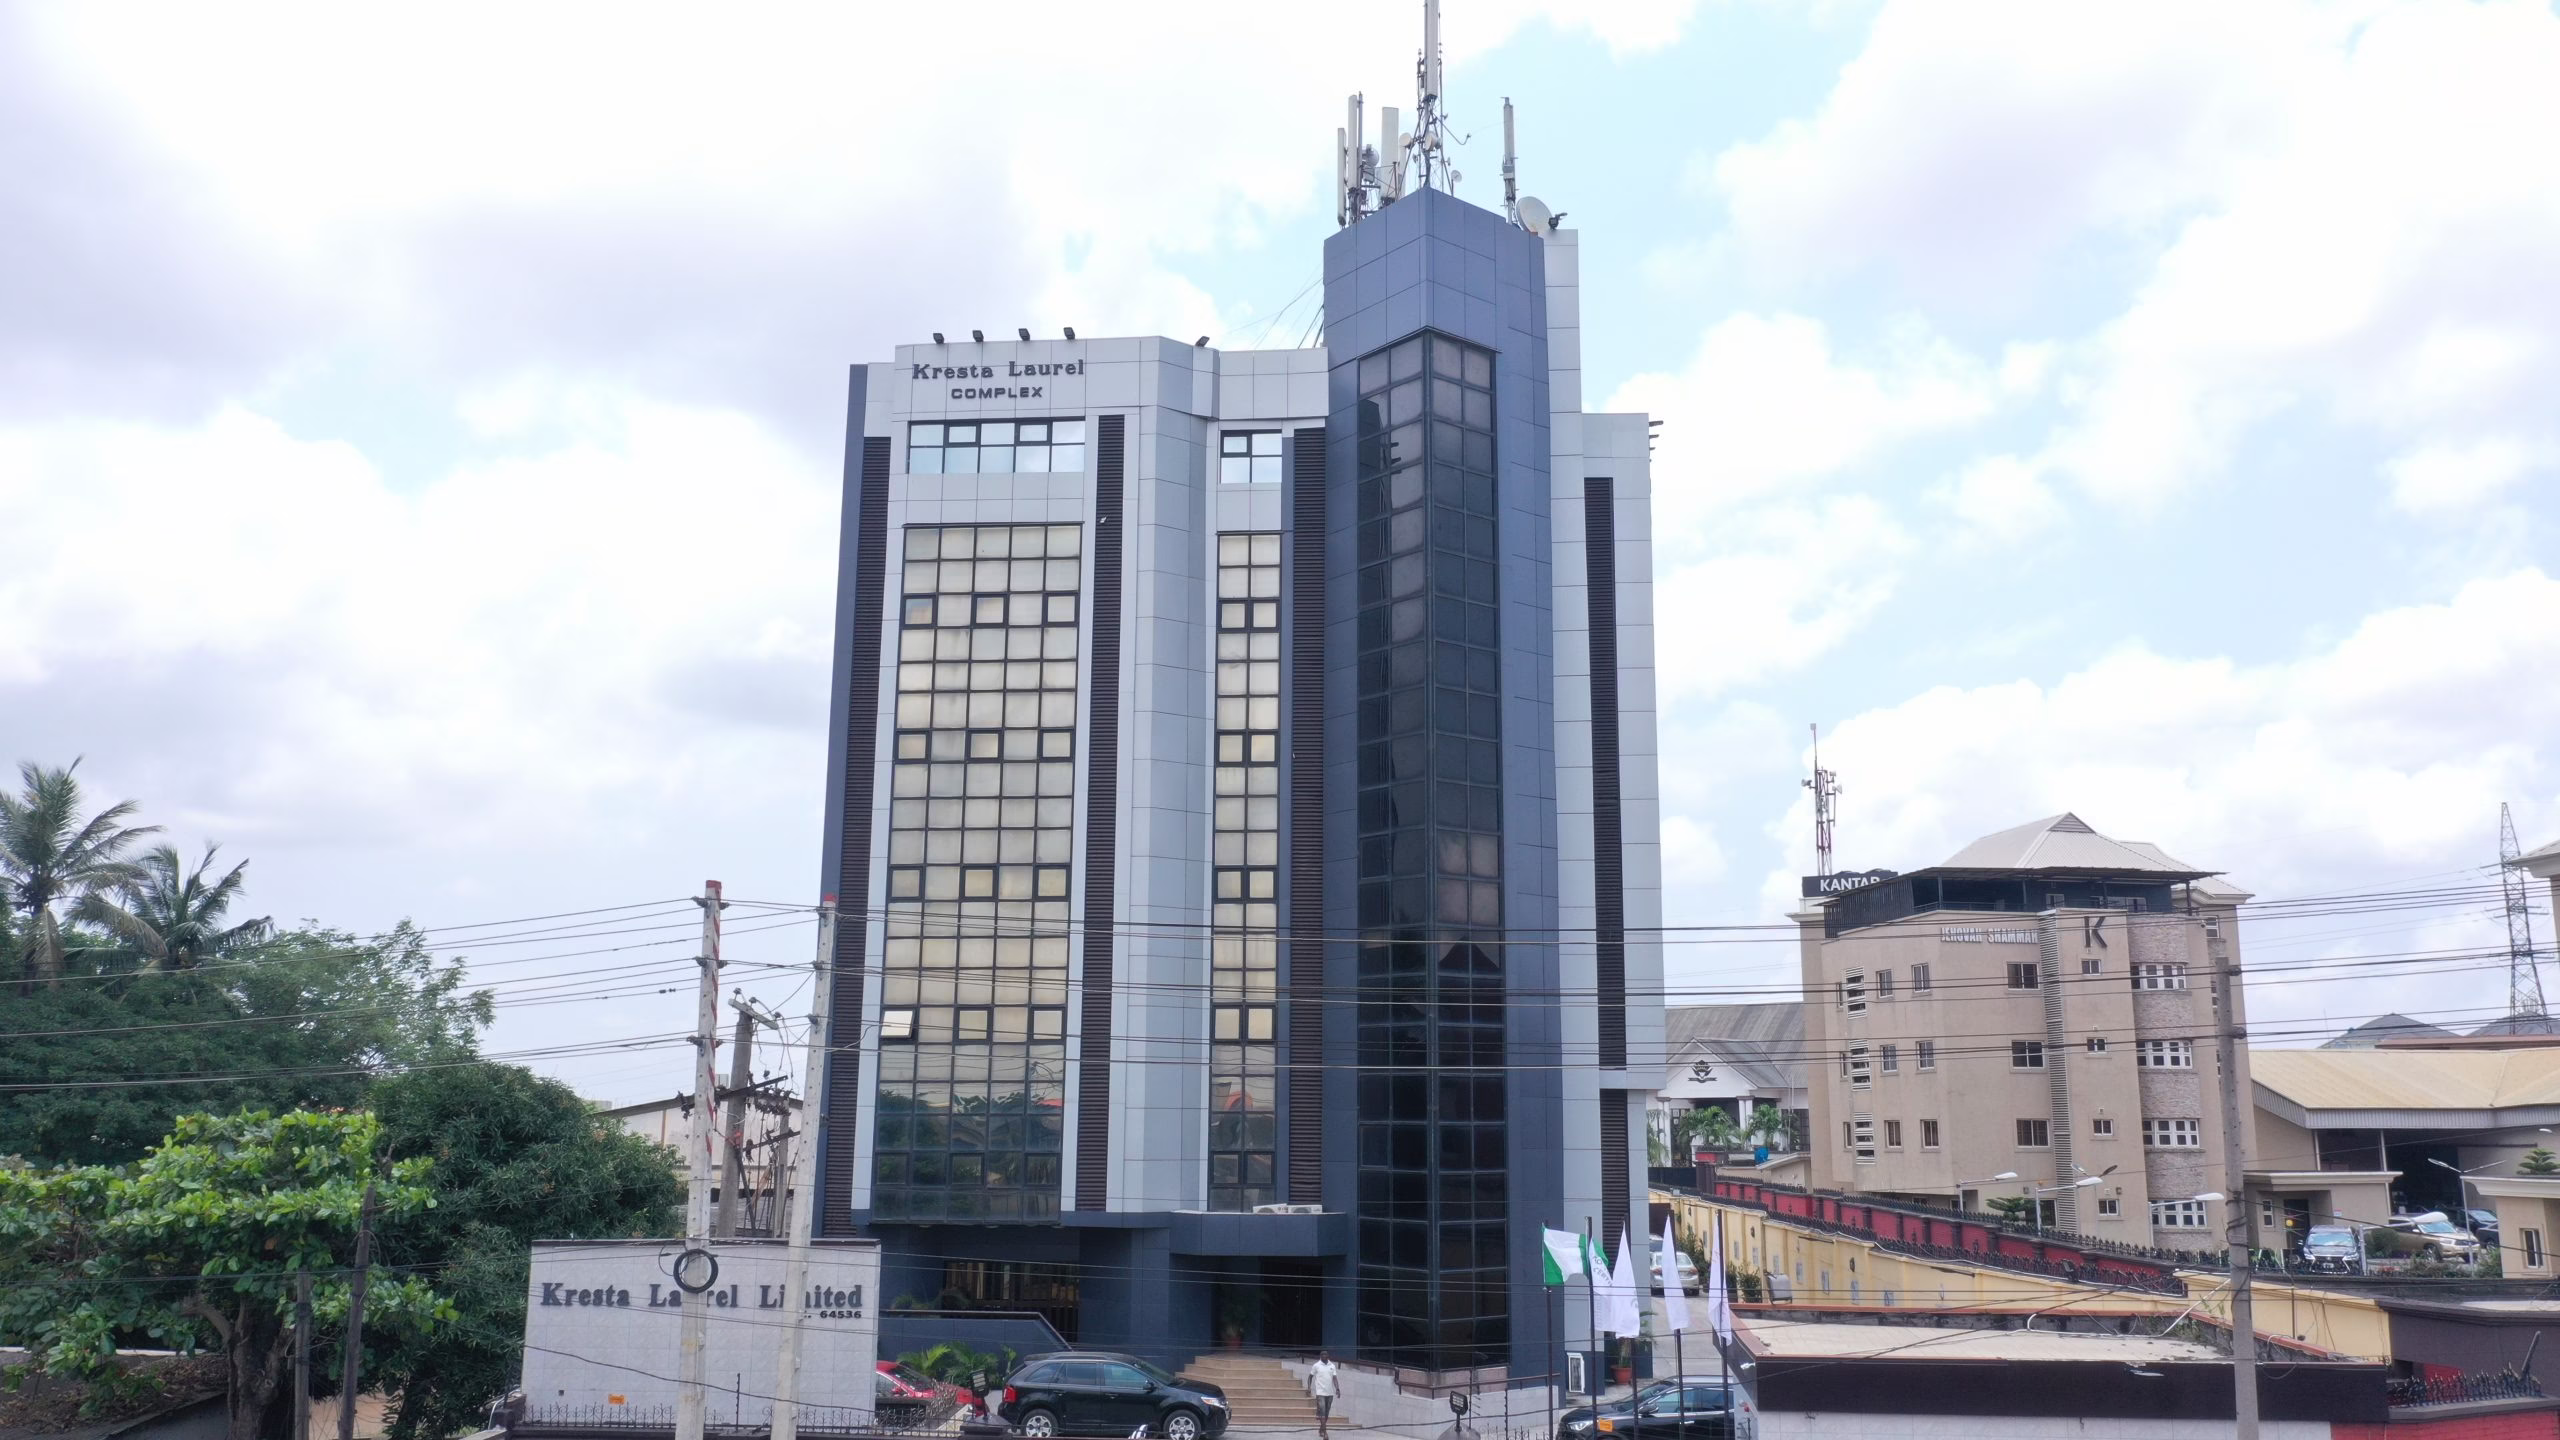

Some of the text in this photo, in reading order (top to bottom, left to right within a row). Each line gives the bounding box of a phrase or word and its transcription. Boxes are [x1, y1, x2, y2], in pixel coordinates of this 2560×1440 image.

[912, 359, 1084, 380] Kresta Laurel
[951, 386, 1043, 399] COMPLEX
[1941, 927, 2040, 944] JEHOVAH SHAMMAH
[2084, 916, 2107, 948] K
[541, 1282, 630, 1307] Kresta
[648, 1284, 738, 1308] Larel
[820, 1310, 862, 1319] 64536
